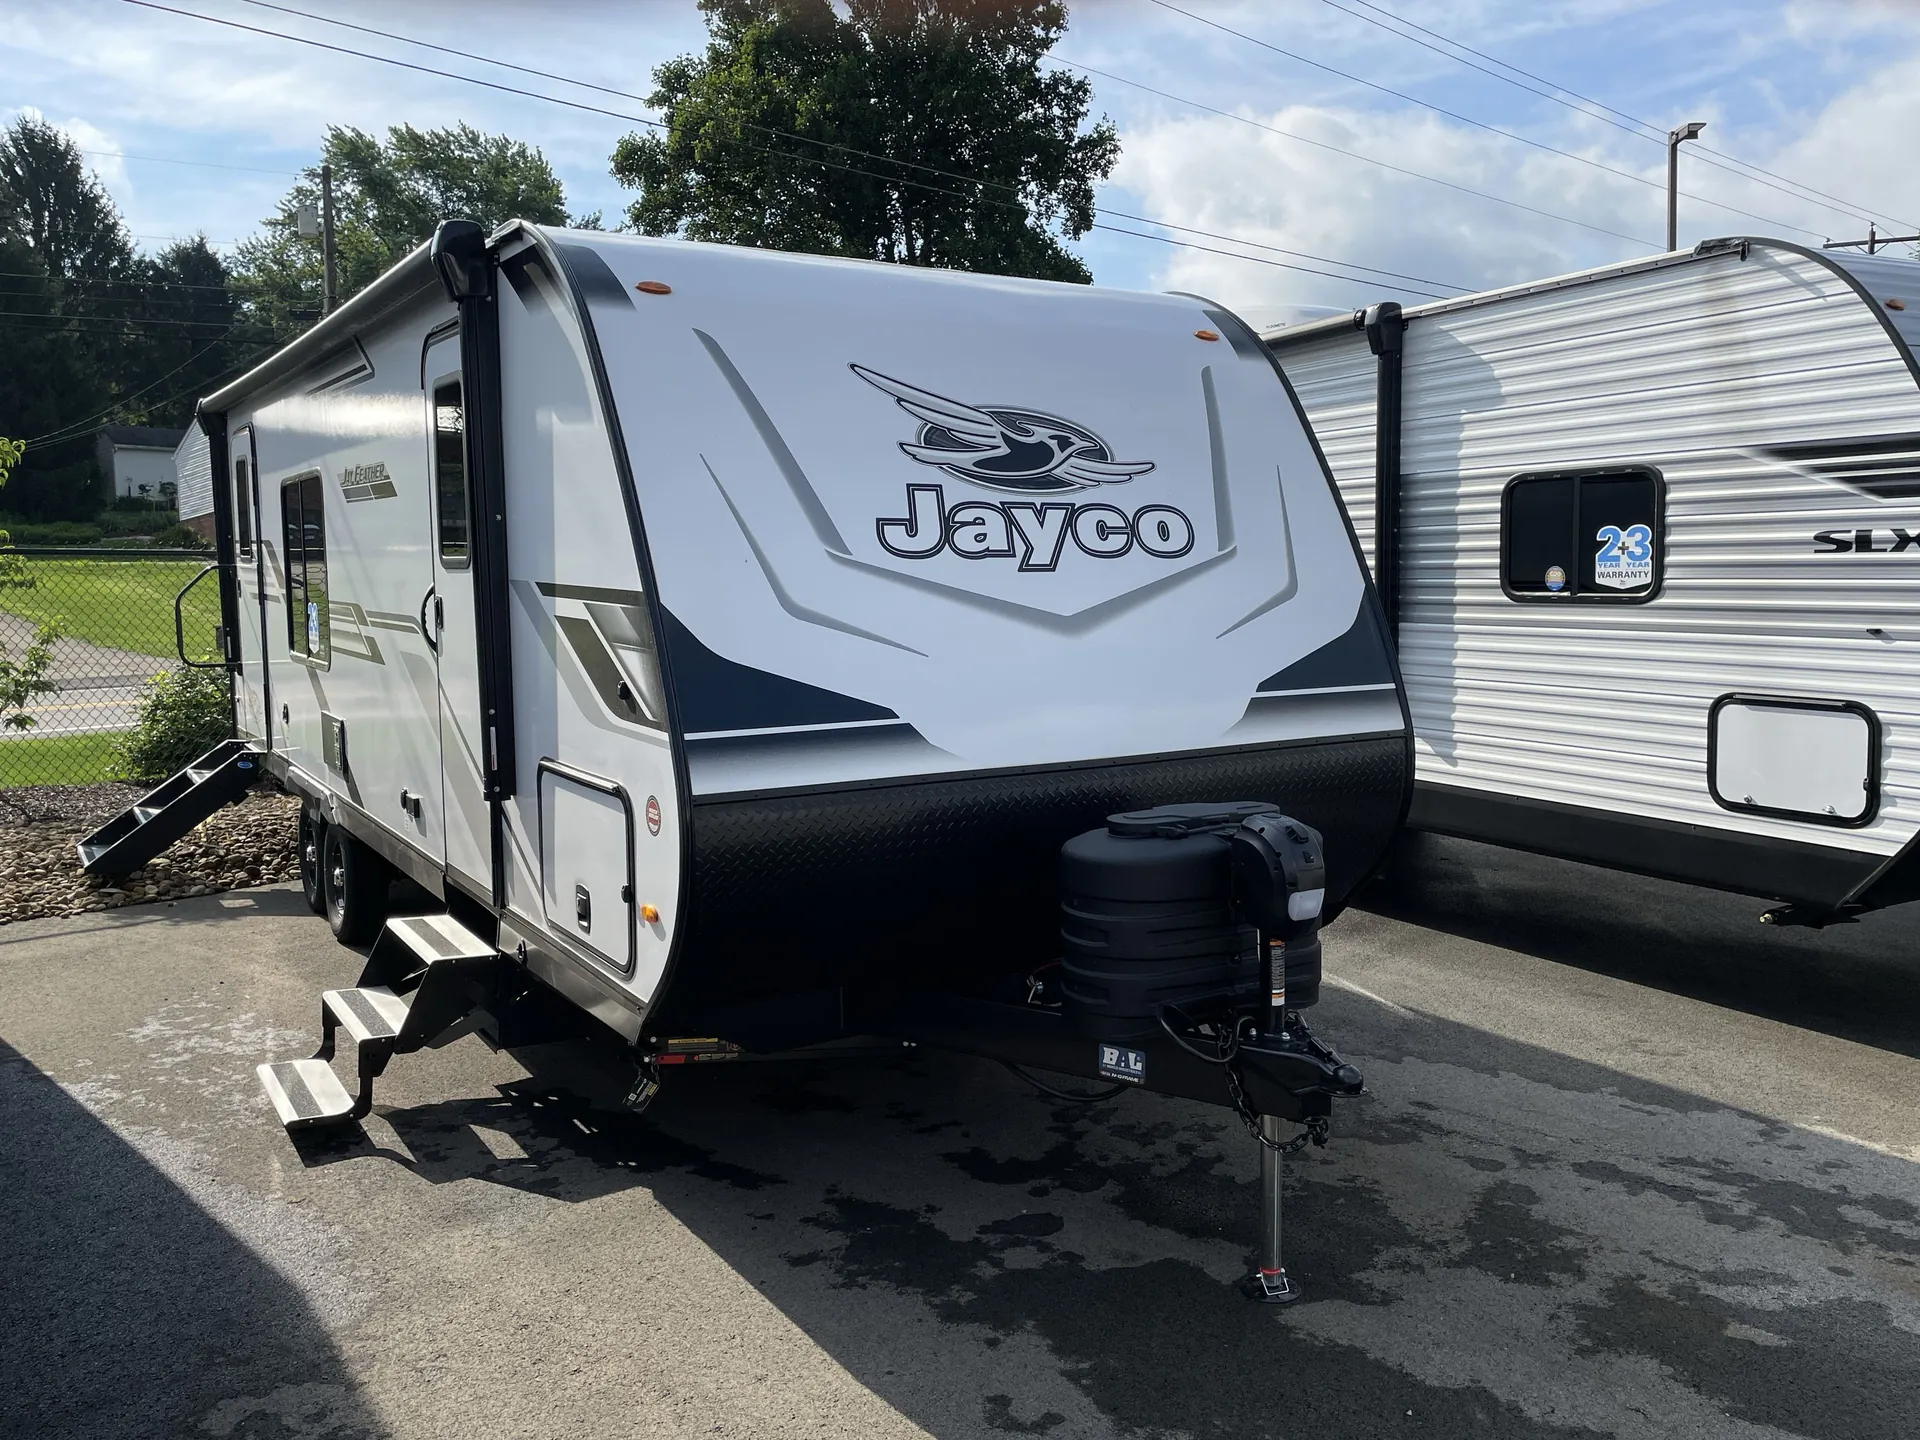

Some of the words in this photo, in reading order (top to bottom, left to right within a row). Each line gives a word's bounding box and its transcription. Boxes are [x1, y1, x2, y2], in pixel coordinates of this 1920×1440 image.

[354, 461, 385, 484] FEATHER
[876, 483, 1194, 572] Jayco
[1597, 570, 1650, 579] WARRANTY
[1102, 1046, 1143, 1071] BAL
